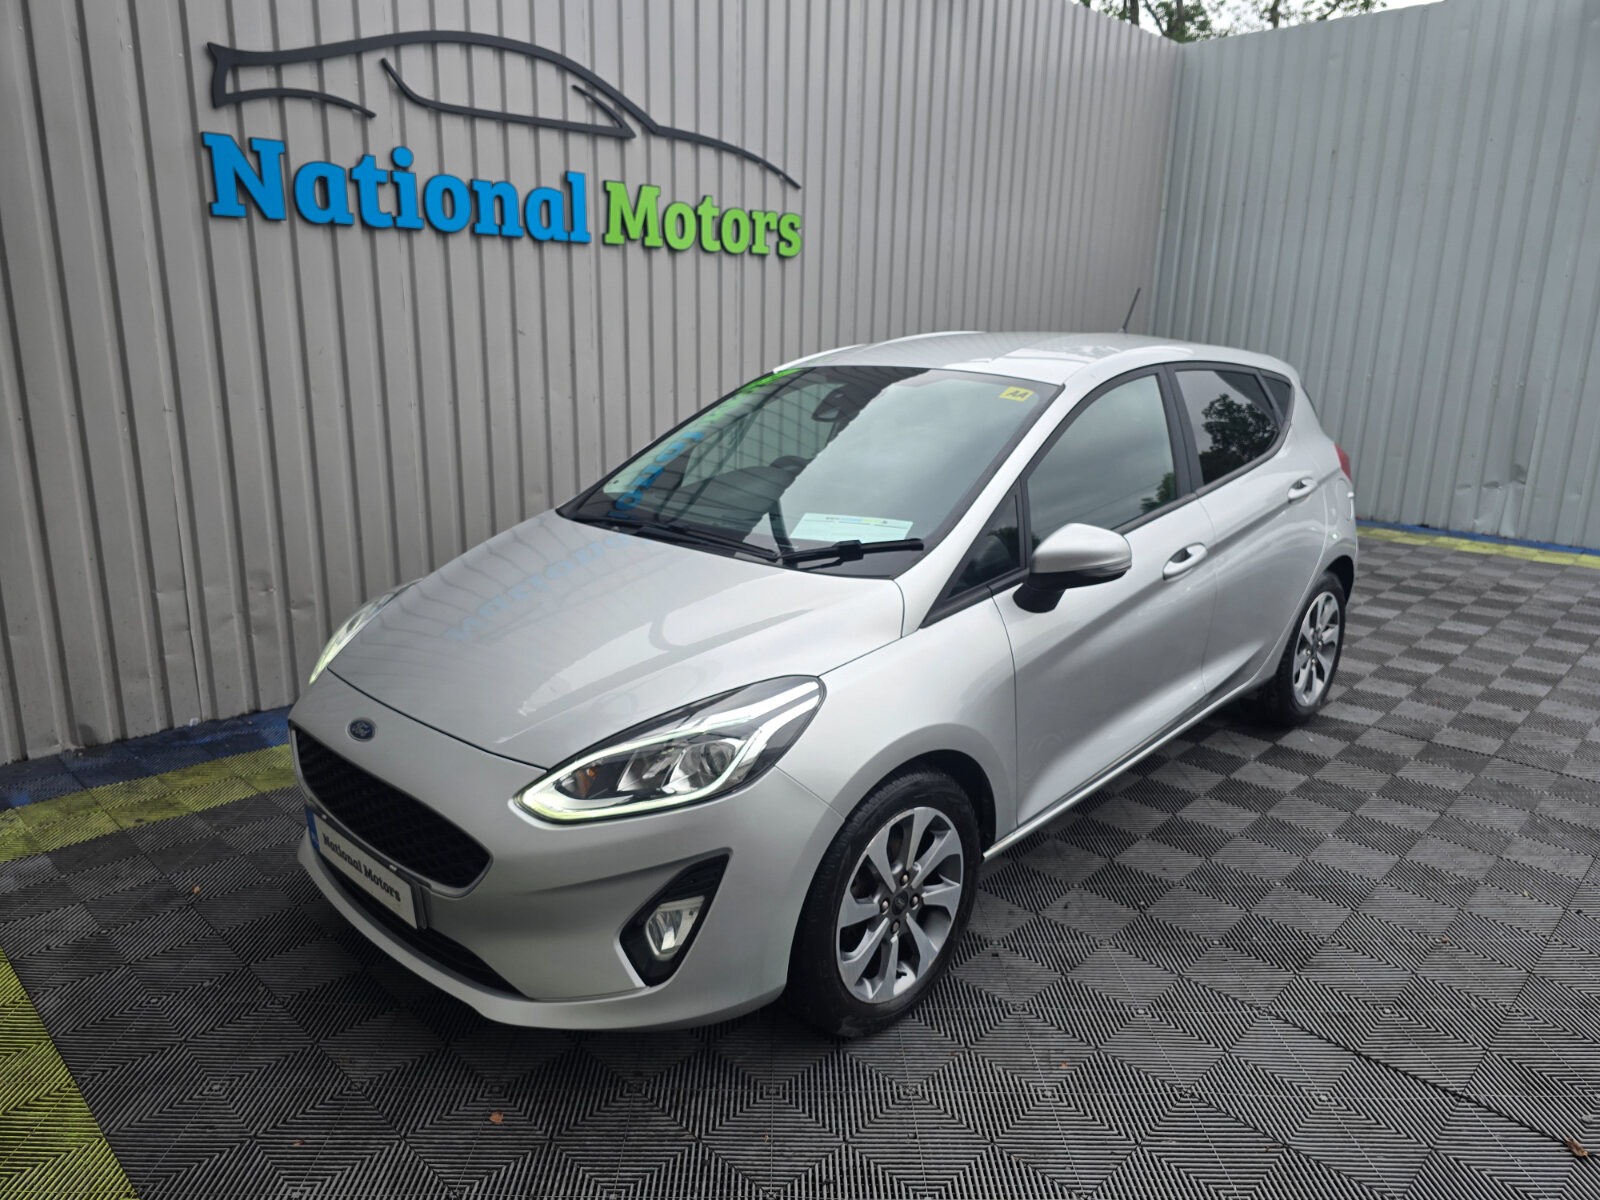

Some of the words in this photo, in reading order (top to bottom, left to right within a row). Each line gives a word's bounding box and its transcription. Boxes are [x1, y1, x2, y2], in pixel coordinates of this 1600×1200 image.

[201, 131, 592, 244] National
[602, 179, 803, 258] Motors
[322, 832, 363, 874] National
[363, 863, 401, 902] Motors
